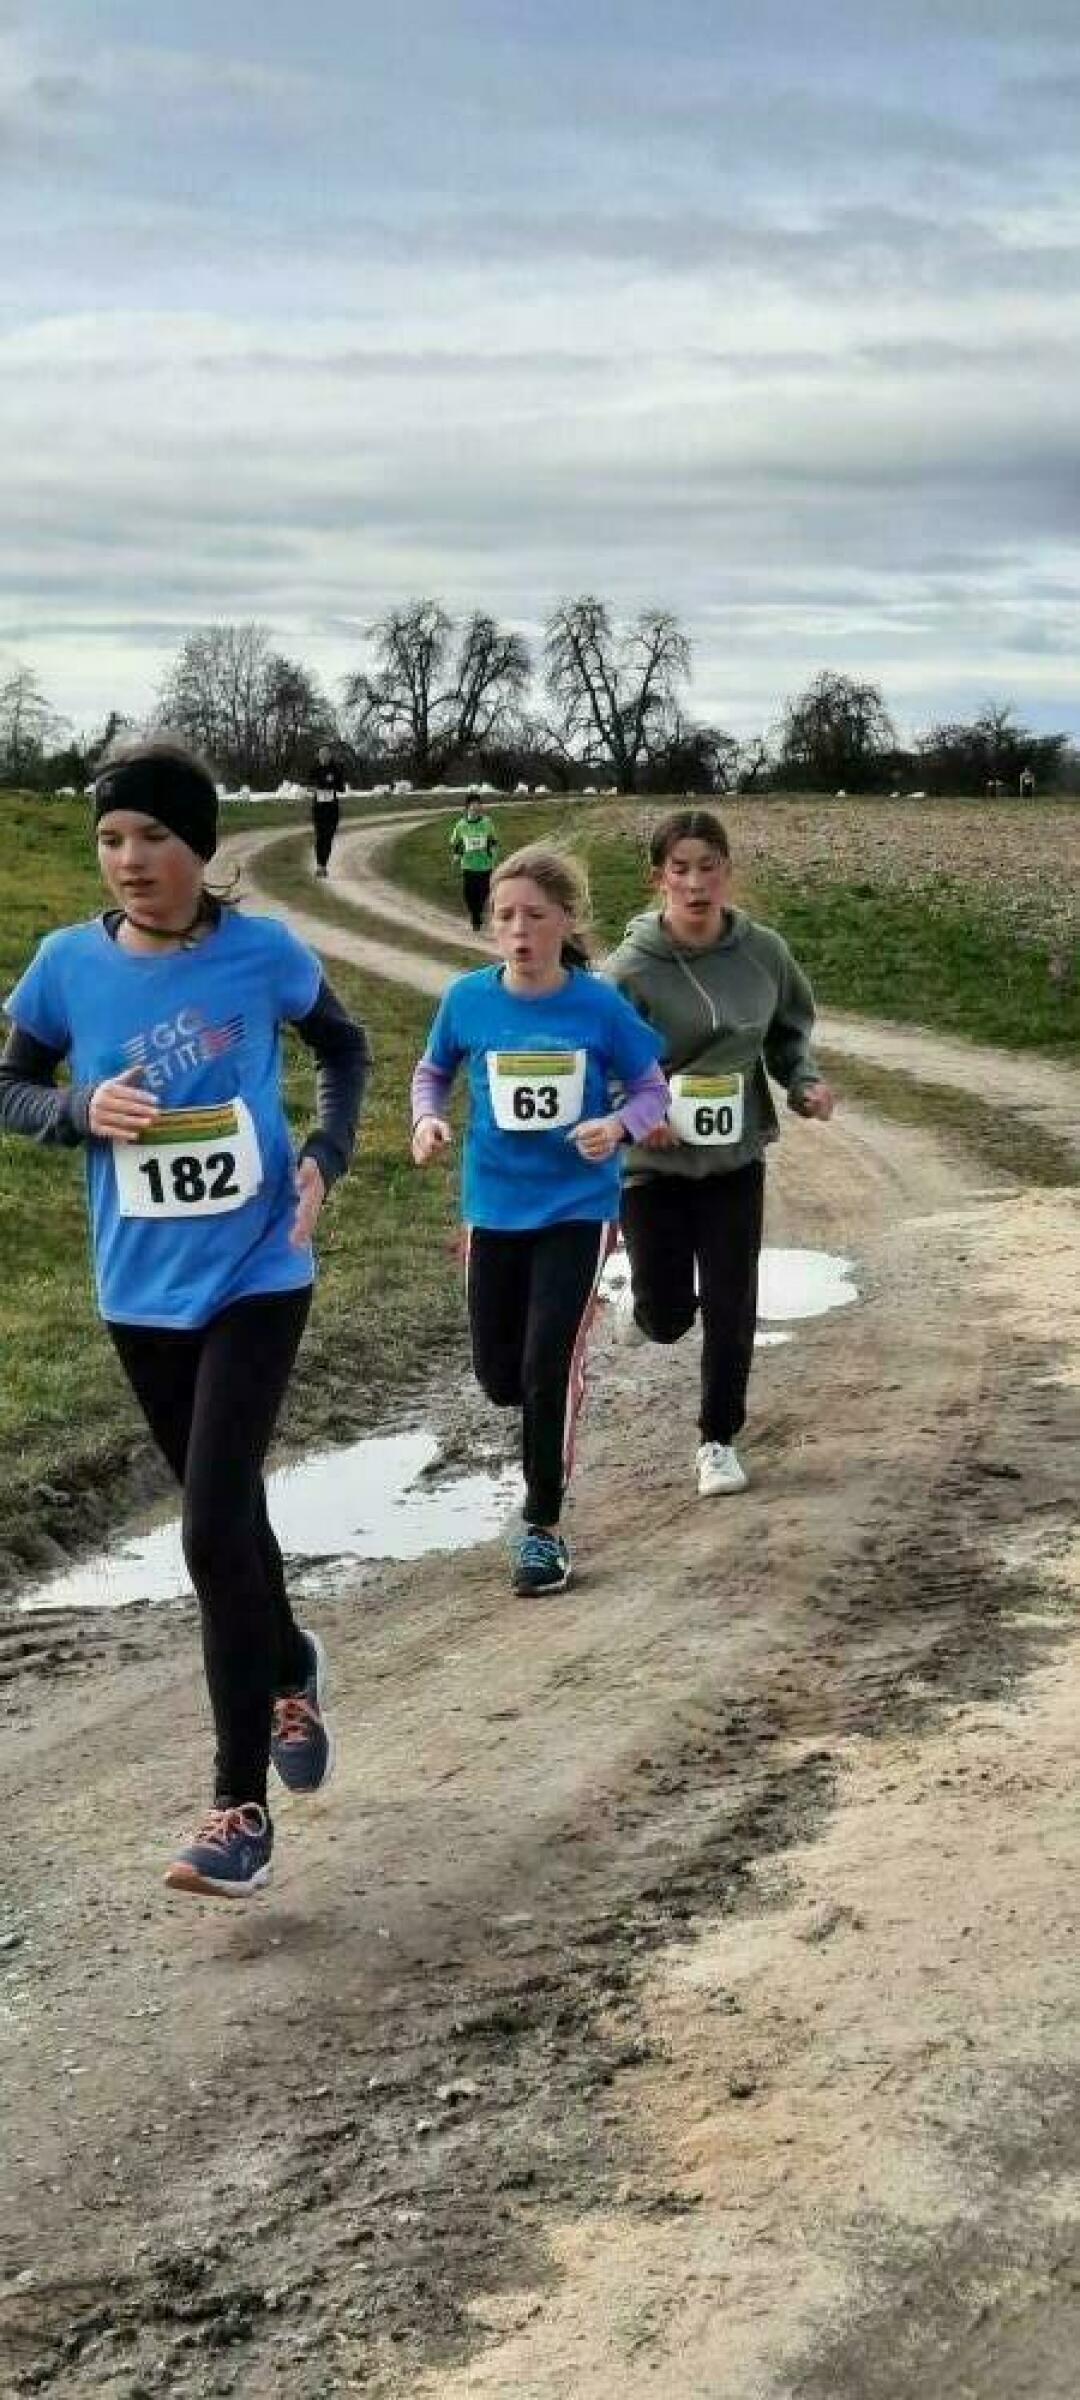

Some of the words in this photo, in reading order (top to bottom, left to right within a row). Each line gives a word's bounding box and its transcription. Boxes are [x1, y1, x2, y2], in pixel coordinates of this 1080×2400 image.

[513, 1086, 559, 1120] 63
[695, 1106, 732, 1136] 60
[138, 1152, 240, 1203] 182
